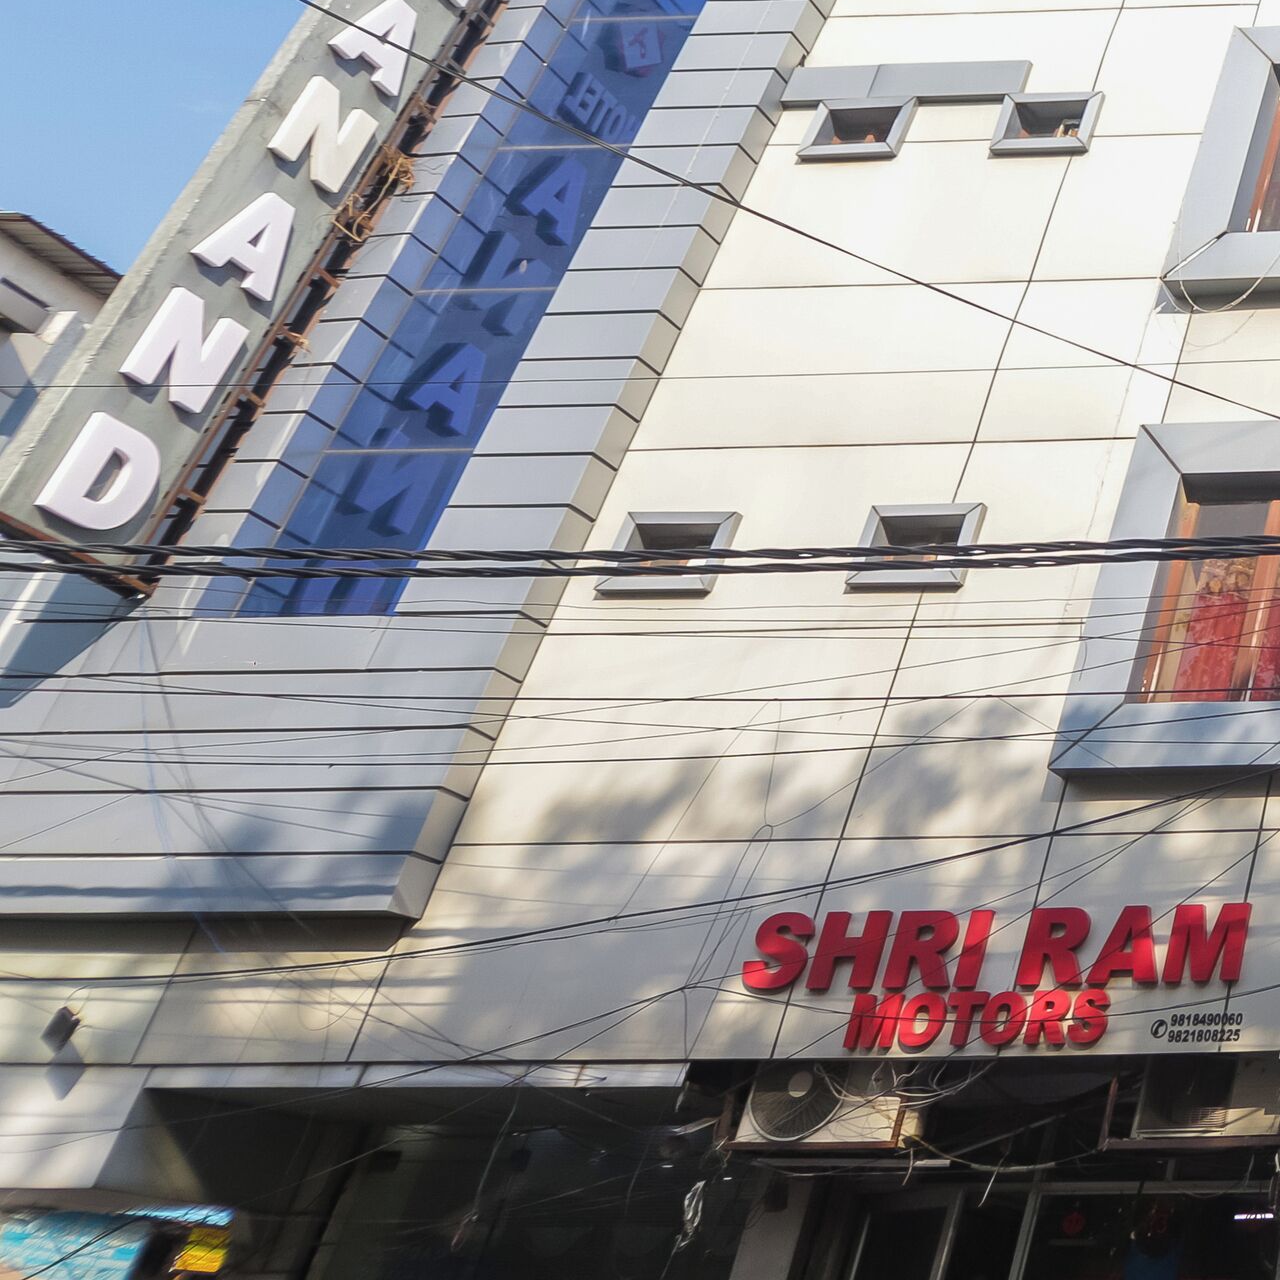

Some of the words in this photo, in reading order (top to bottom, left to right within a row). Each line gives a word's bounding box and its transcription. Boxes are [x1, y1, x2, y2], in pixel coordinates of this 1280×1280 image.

[742, 909, 996, 992] SHRI
[1015, 902, 1253, 989] RAM
[843, 988, 1111, 1051] MOTORS
[1167, 1029, 1241, 1043] 9821808225
[1170, 1013, 1243, 1026] 9818490060
